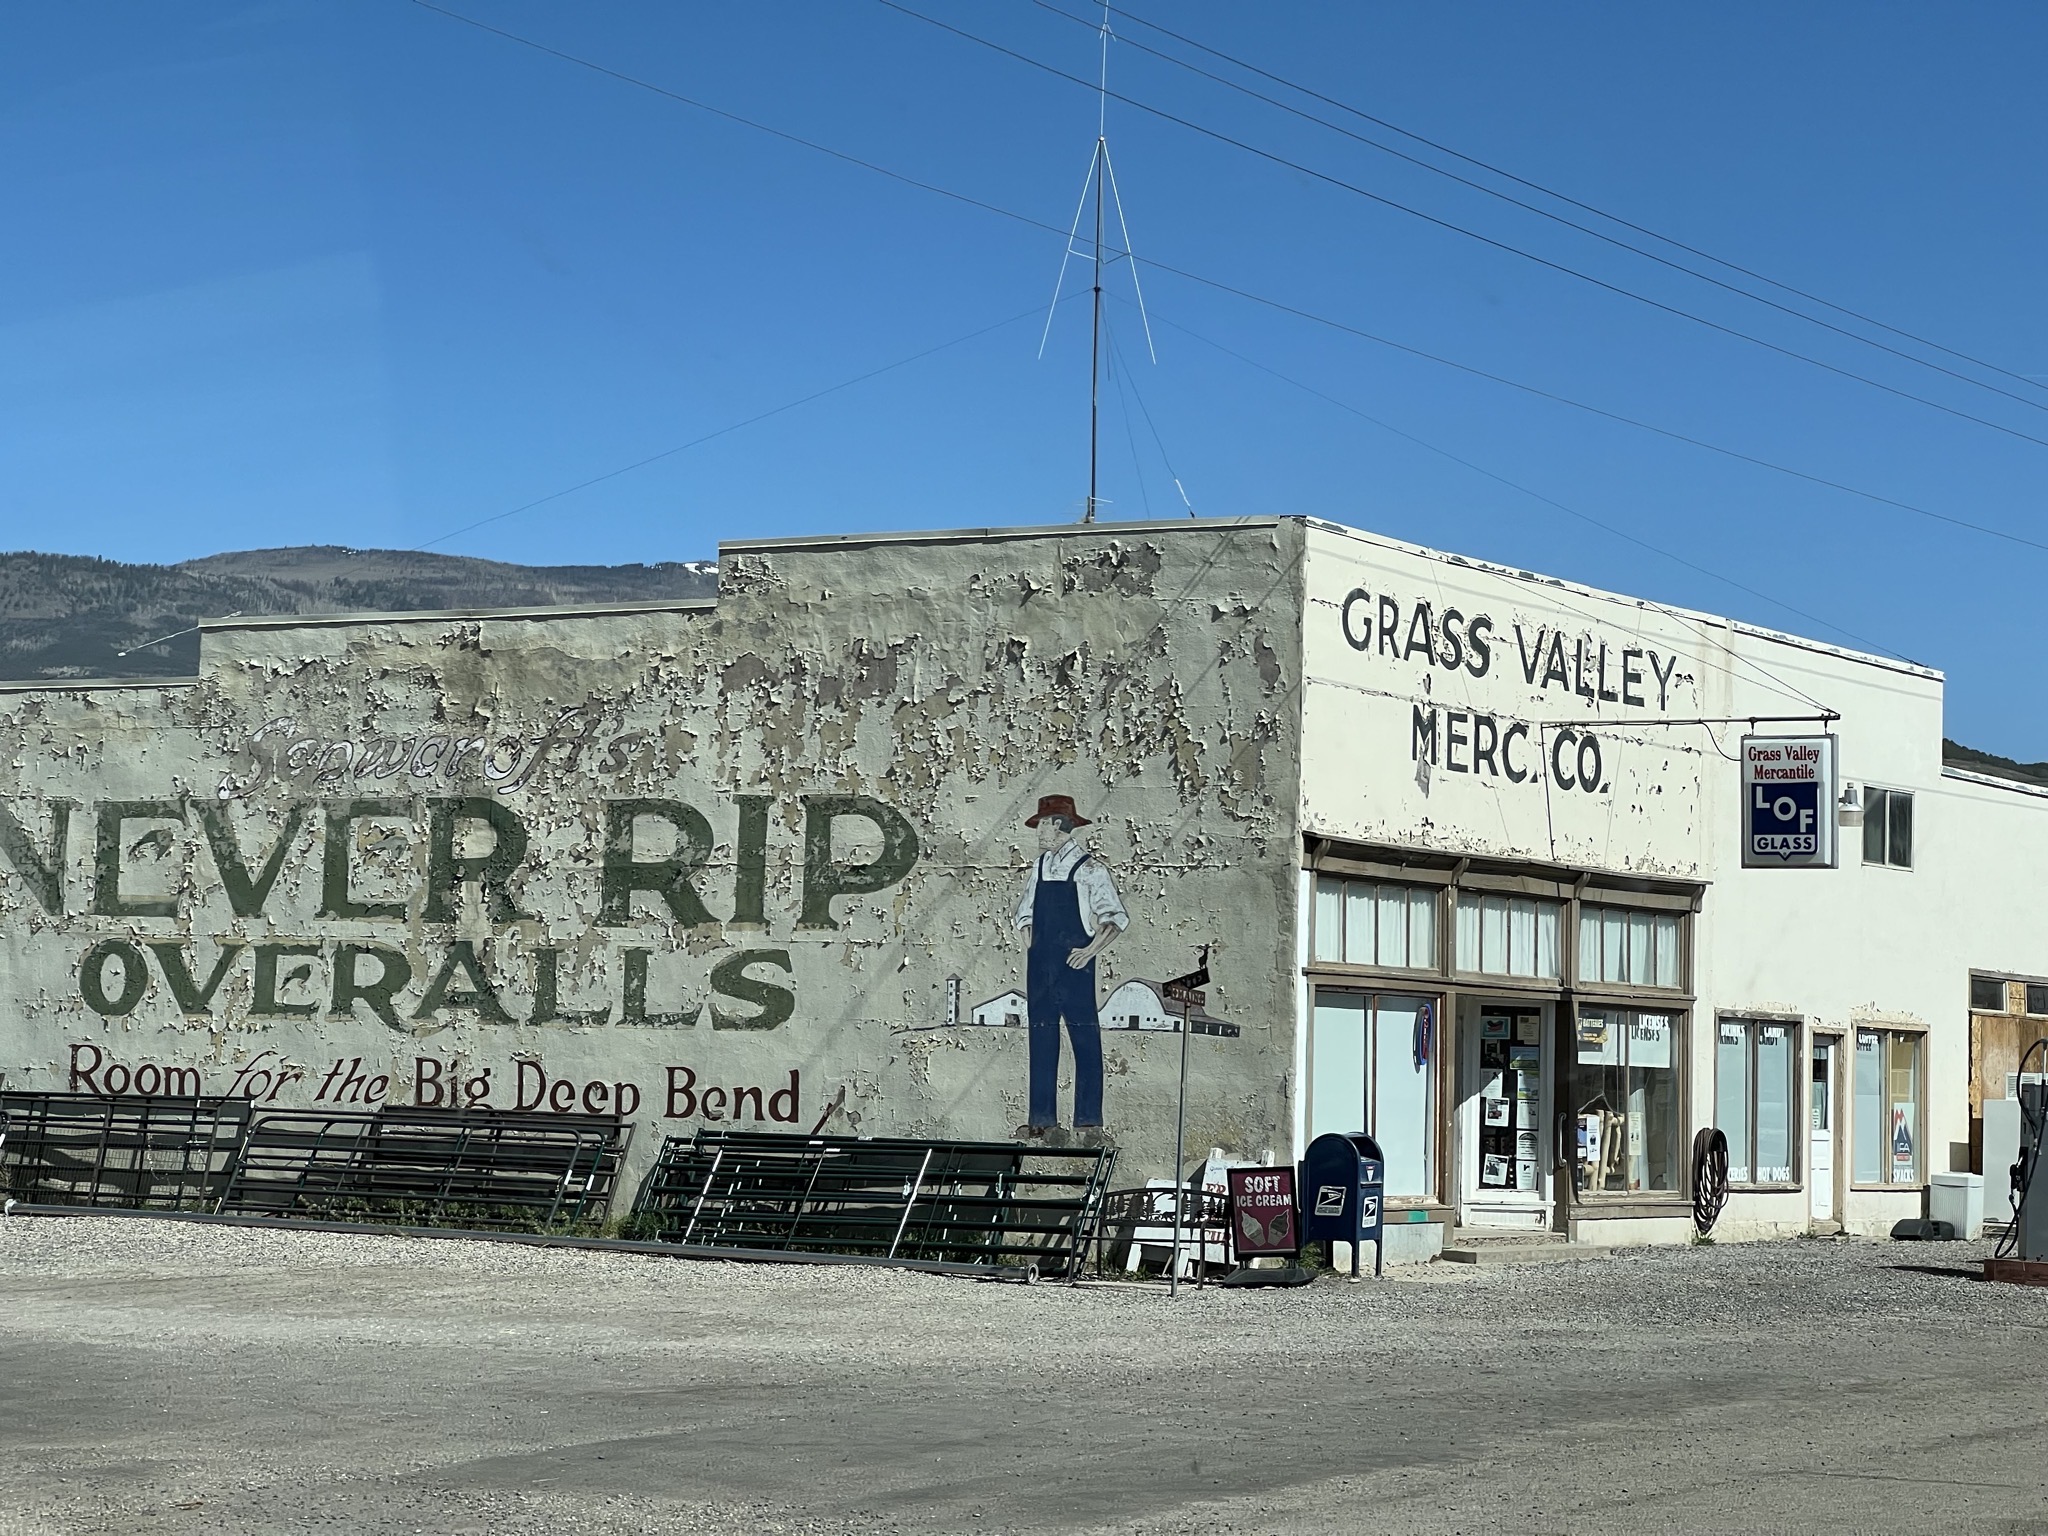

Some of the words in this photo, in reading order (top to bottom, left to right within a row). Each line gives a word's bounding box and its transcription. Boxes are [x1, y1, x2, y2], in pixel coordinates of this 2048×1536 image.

[1342, 588, 1493, 678] GRASS
[1513, 623, 1678, 711] VALLEY
[1411, 704, 1539, 783] MERC.
[1552, 729, 1610, 793] CO.
[1748, 746, 1781, 761] Grass
[1784, 745, 1820, 764] Valley
[1754, 764, 1815, 780] Mercantile
[1756, 786, 1814, 833] LOF
[1757, 837, 1812, 850] GLASS
[0, 796, 537, 924] NEVER
[593, 794, 920, 931] RIP
[79, 938, 796, 1032] OVERALLS
[1639, 1014, 1669, 1031] LICENSES
[1720, 1024, 1746, 1037] DRINKS
[68, 1043, 200, 1097] Room
[226, 1050, 302, 1101] for
[312, 1057, 391, 1103] the
[414, 1057, 492, 1109] Big
[513, 1060, 641, 1115] Deep
[663, 1066, 800, 1124] Bend
[1757, 1167, 1771, 1182] HOT
[1772, 1166, 1790, 1181] DOGS
[1244, 1175, 1281, 1193] SOFT
[1236, 1195, 1253, 1208] ICE
[1255, 1194, 1292, 1207] CREAM
